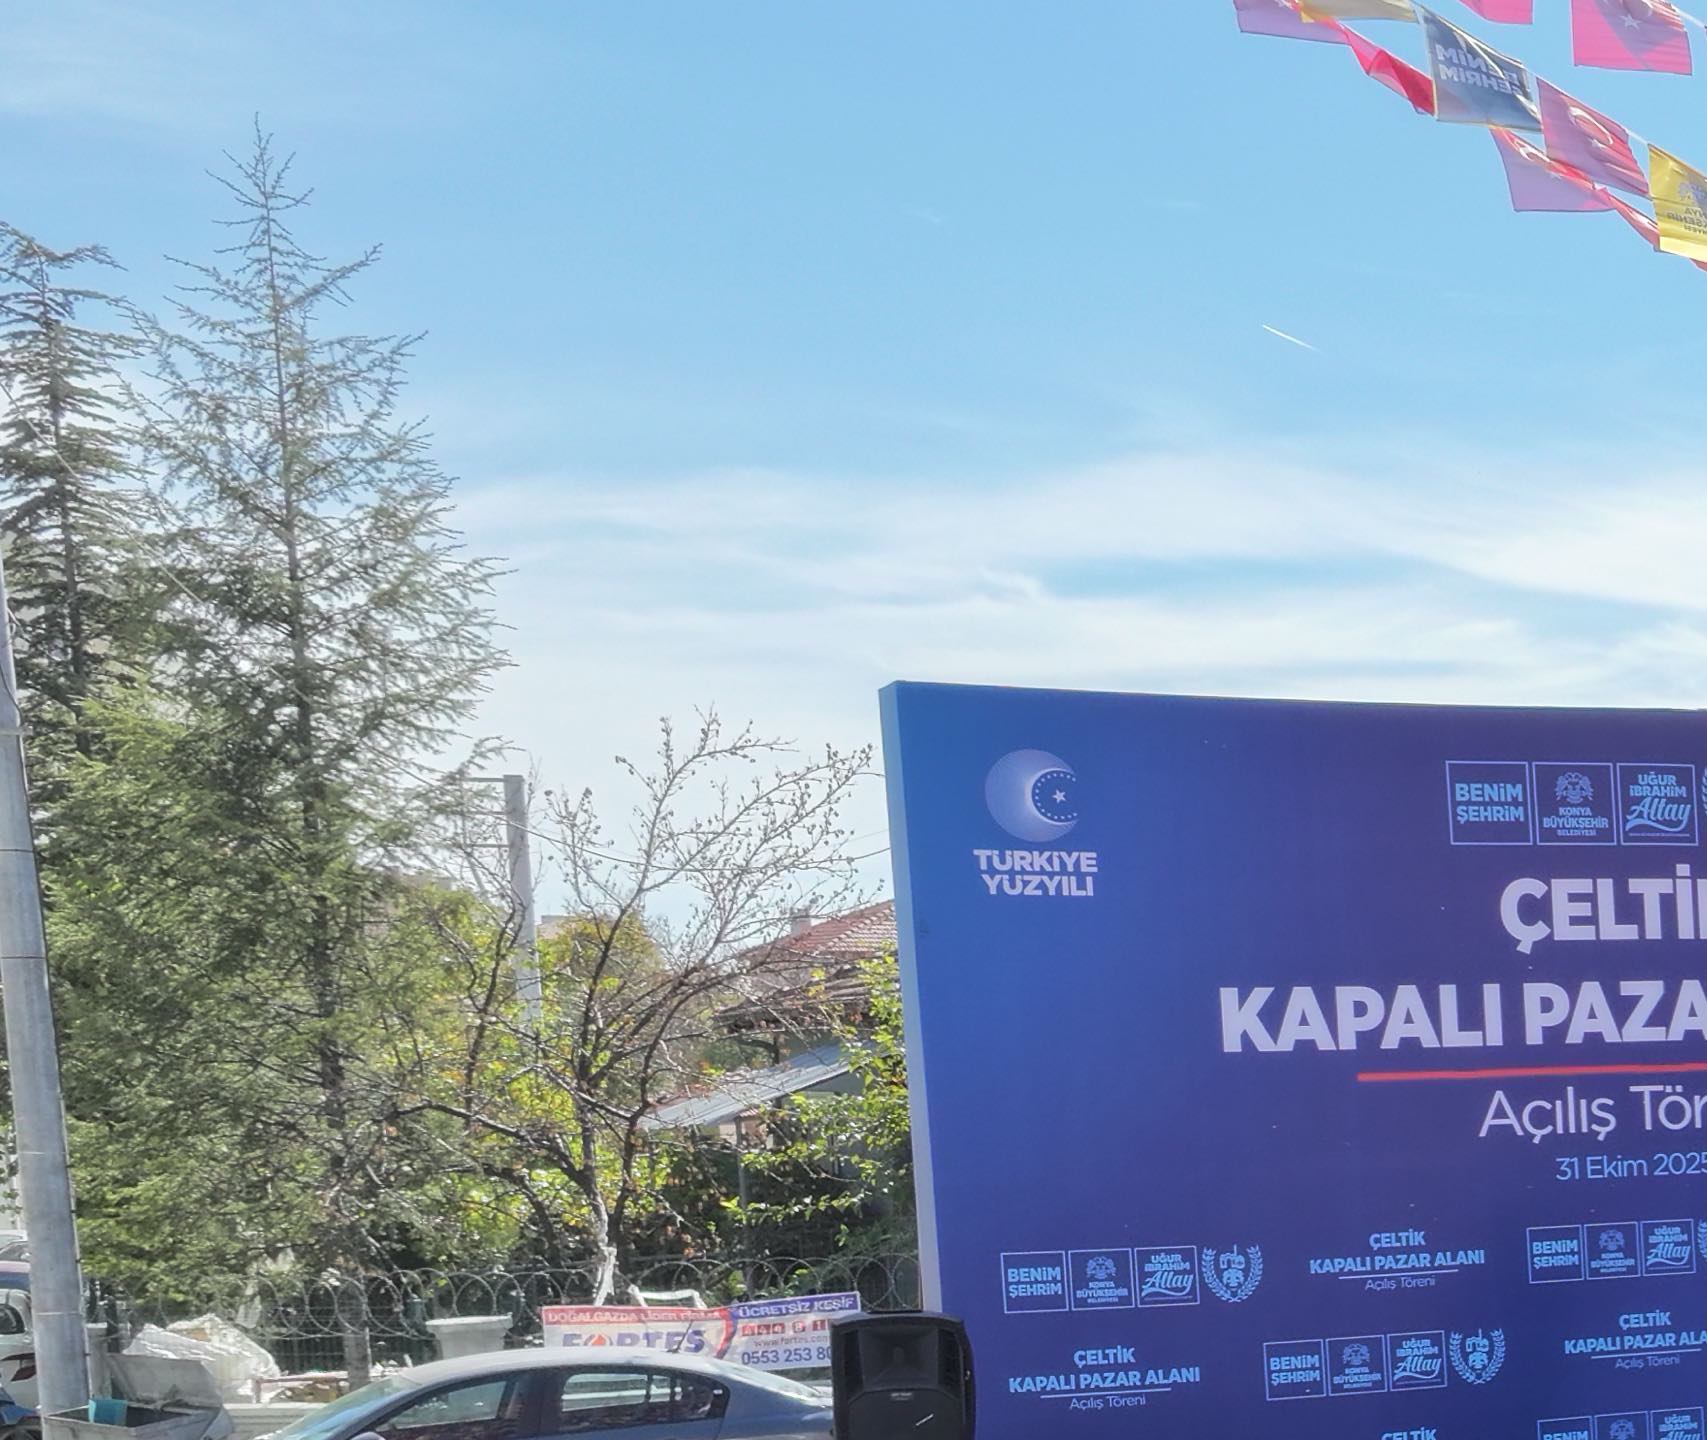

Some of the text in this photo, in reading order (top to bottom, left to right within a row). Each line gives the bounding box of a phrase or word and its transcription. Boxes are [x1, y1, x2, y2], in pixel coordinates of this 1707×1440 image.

[1638, 772, 1677, 786] UĞUR
[1455, 783, 1523, 802] BENİM
[1629, 785, 1687, 798] İBRAHİM
[1457, 806, 1524, 824] ŞEHRİM
[1559, 807, 1592, 816] KONYA
[1626, 797, 1692, 832] Altay
[1543, 815, 1608, 829] BÜYÜKŞEHİR
[973, 848, 1098, 872] TÜRKİYE
[981, 874, 1094, 897] YÜZYILI
[1219, 984, 1504, 1053] KAPALI
[1479, 1089, 1617, 1144] Açılış
[1556, 1156, 1580, 1181] 31
[1586, 1153, 1646, 1179] Ekim
[1369, 1229, 1425, 1250] ÇELTİK
[1310, 1250, 1485, 1274] KAPALI PAZAR ALANI
[1008, 1267, 1061, 1282] BENİM
[1009, 1283, 1062, 1298] ŞEHRİM
[739, 1302, 810, 1318] ÜCRETSİZ
[1619, 1310, 1671, 1330] ÇELTİK
[1565, 1337, 1620, 1354] KAPALI
[1624, 1333, 1676, 1349] PAZAR
[742, 1350, 779, 1365] 0553
[783, 1347, 812, 1362] 253
[1074, 1345, 1136, 1368] ÇELTİK
[1270, 1355, 1320, 1370] BENİM
[1009, 1367, 1200, 1393] KAPALI PAZAR ALANI
[1271, 1370, 1320, 1385] ŞEHRİM
